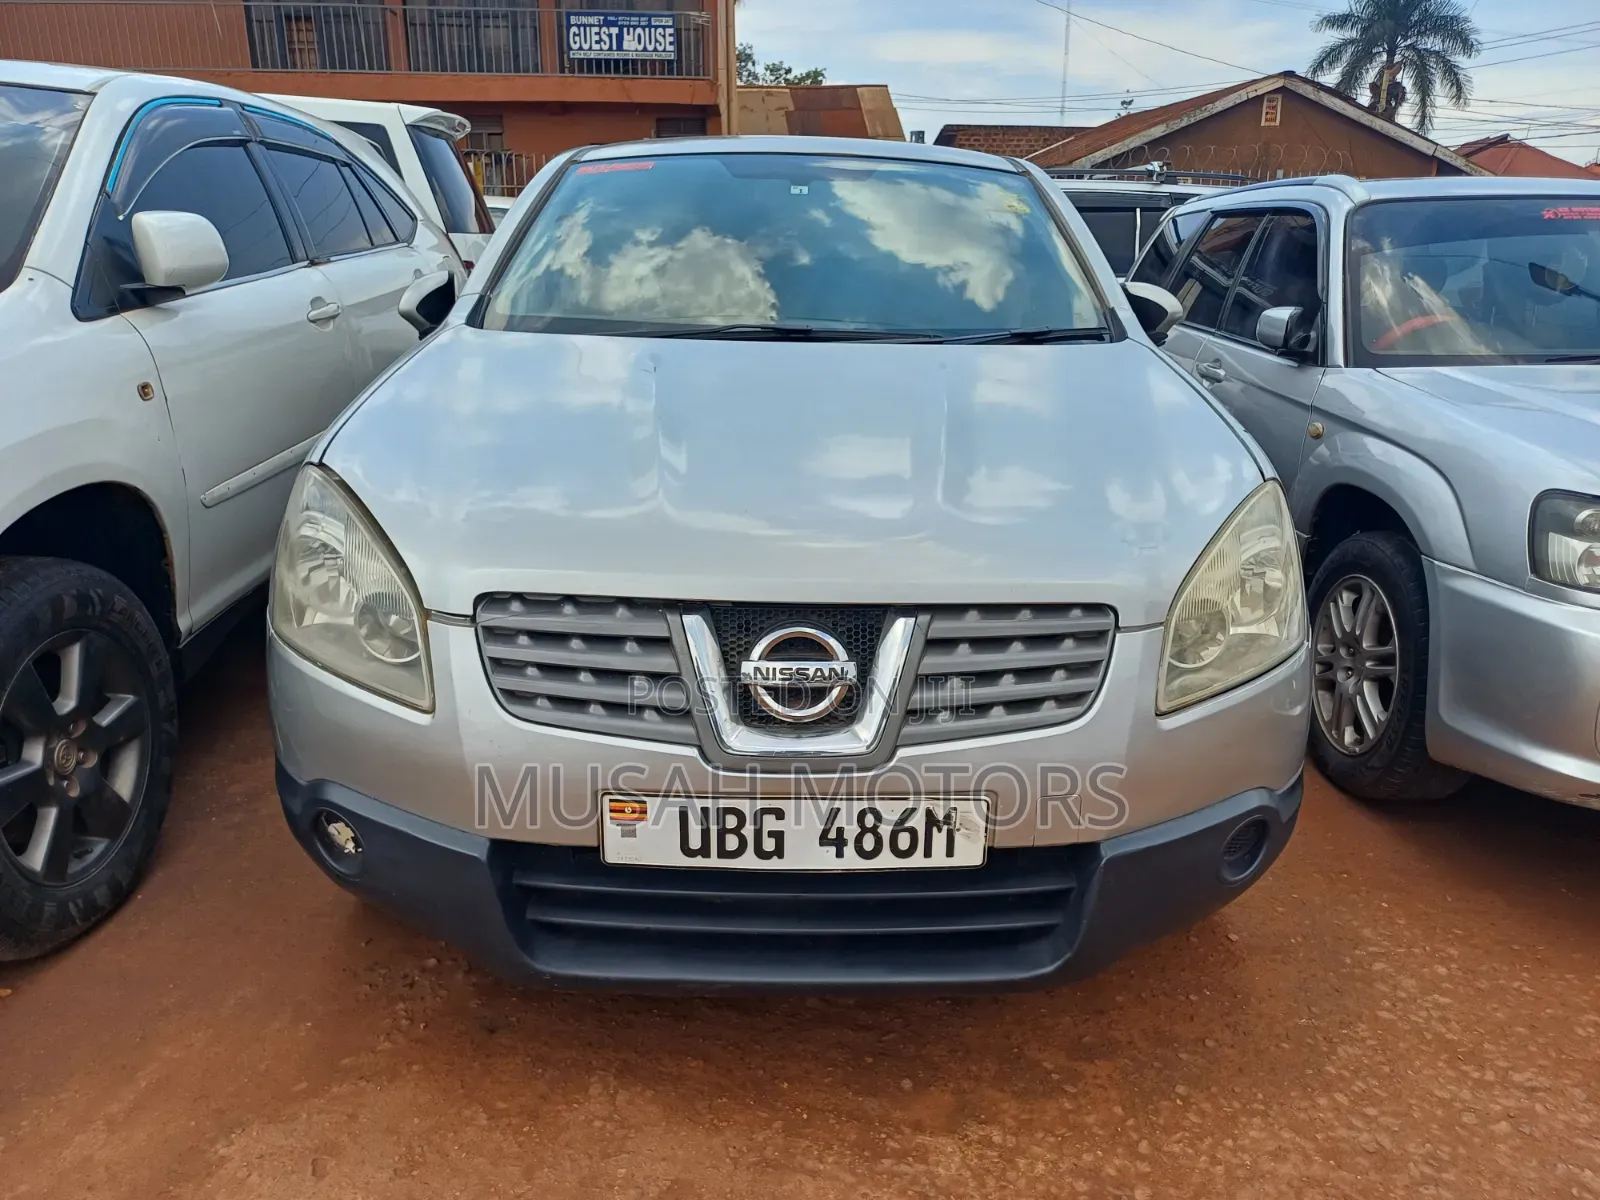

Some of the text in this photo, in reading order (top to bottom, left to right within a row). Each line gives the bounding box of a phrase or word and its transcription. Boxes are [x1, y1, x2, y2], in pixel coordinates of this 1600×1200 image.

[570, 16, 604, 25] BUNNET
[569, 26, 675, 51] GUEST HOUSE
[753, 667, 845, 681] NISSAN
[678, 805, 957, 860] UBG 486M
